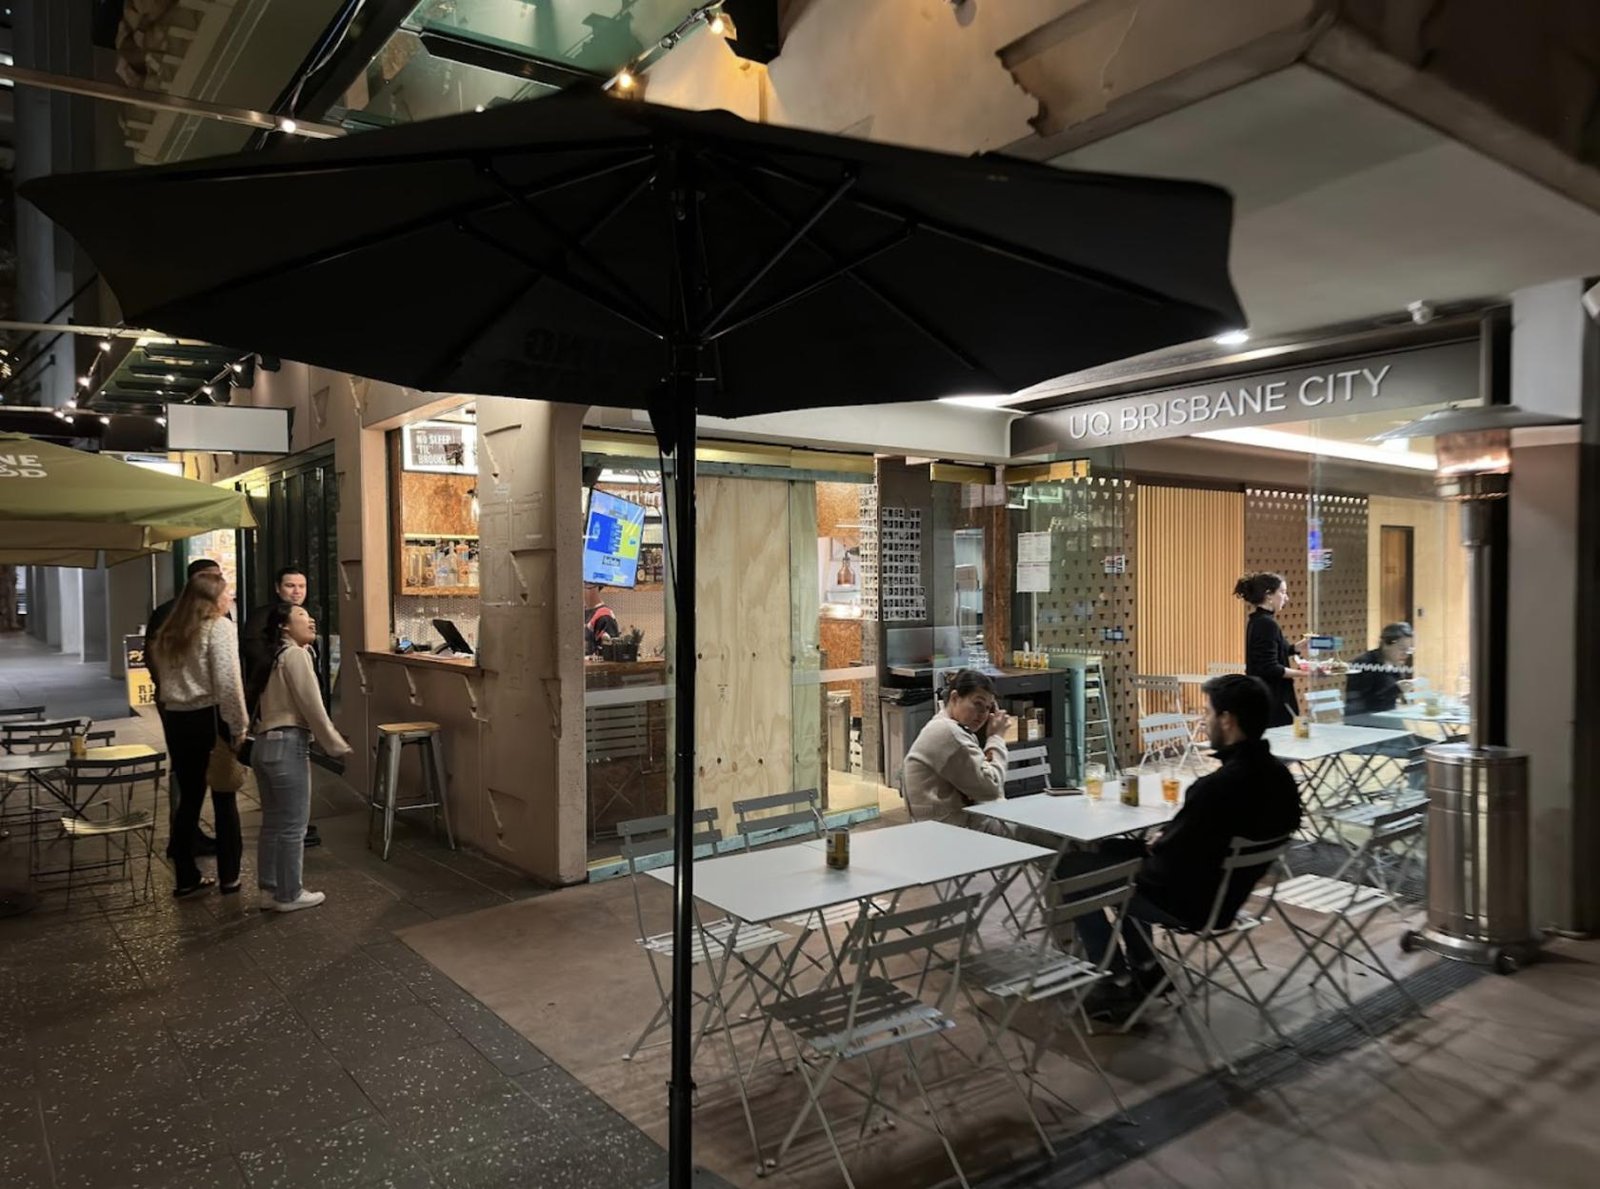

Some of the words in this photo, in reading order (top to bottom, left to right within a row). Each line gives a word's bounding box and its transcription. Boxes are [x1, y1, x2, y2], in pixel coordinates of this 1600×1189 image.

[1068, 410, 1112, 440] UQ
[1119, 381, 1288, 432] BRISBANE
[1298, 364, 1392, 407] CITY
[428, 434, 450, 444] SLEEP
[418, 454, 456, 465] BROOKL
